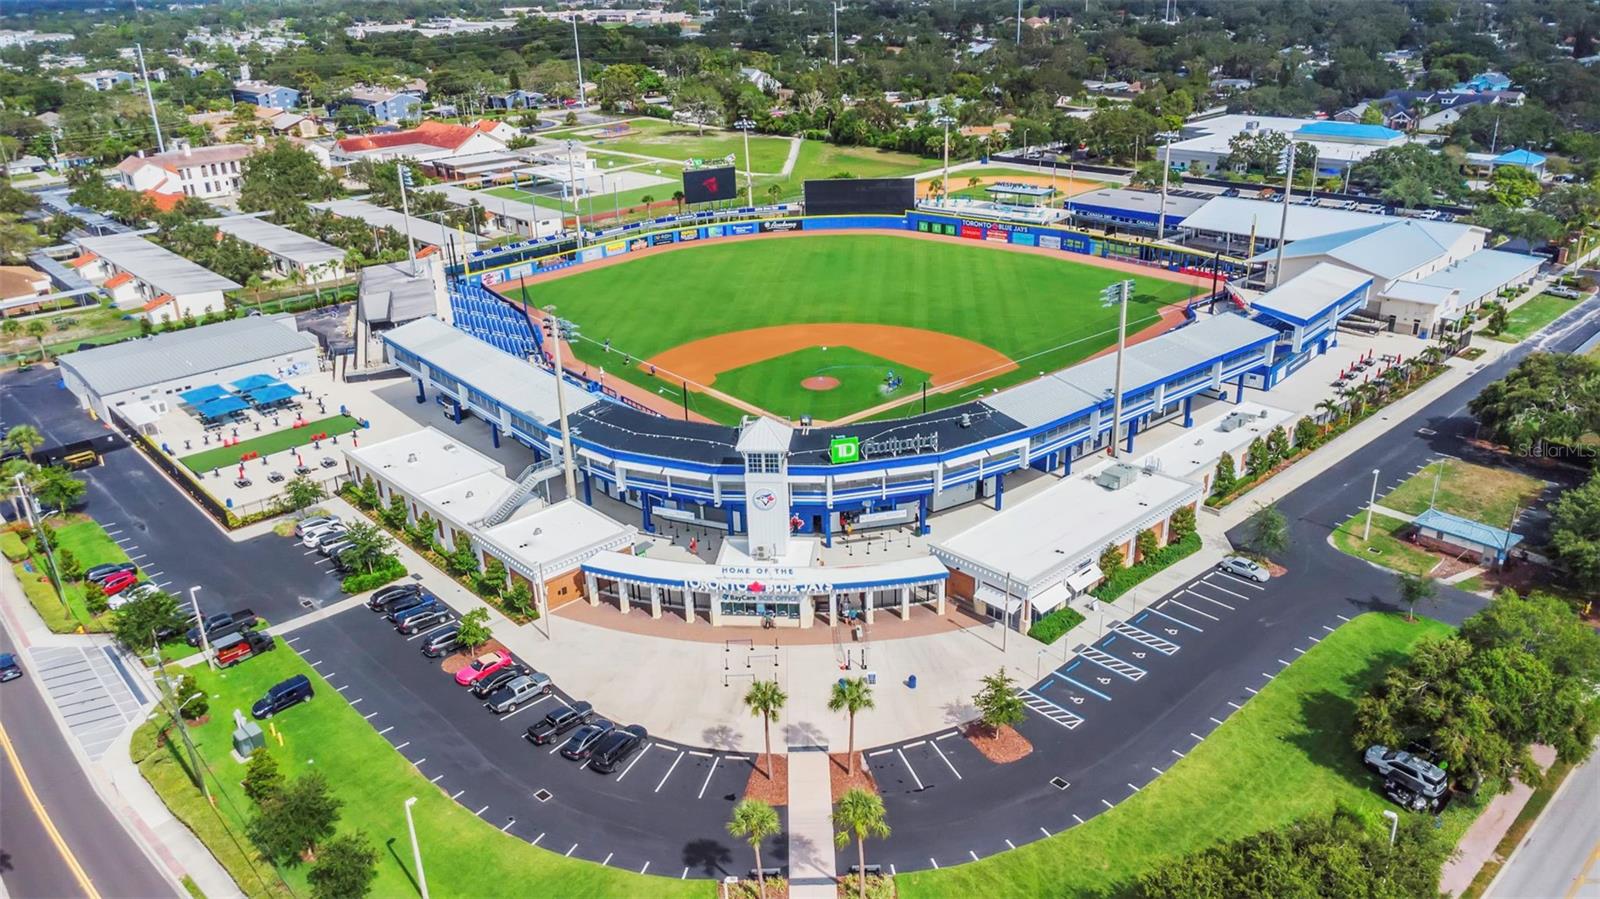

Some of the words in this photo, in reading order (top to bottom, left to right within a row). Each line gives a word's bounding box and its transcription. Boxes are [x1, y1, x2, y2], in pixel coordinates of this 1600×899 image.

[962, 219, 992, 229] TORONTO
[998, 223, 1012, 231] BLUE
[834, 443, 856, 458] TD
[864, 434, 938, 453] Ballpark
[685, 580, 747, 593] TORONTO
[799, 582, 834, 593] JAYS
[730, 594, 757, 602] BayCare
